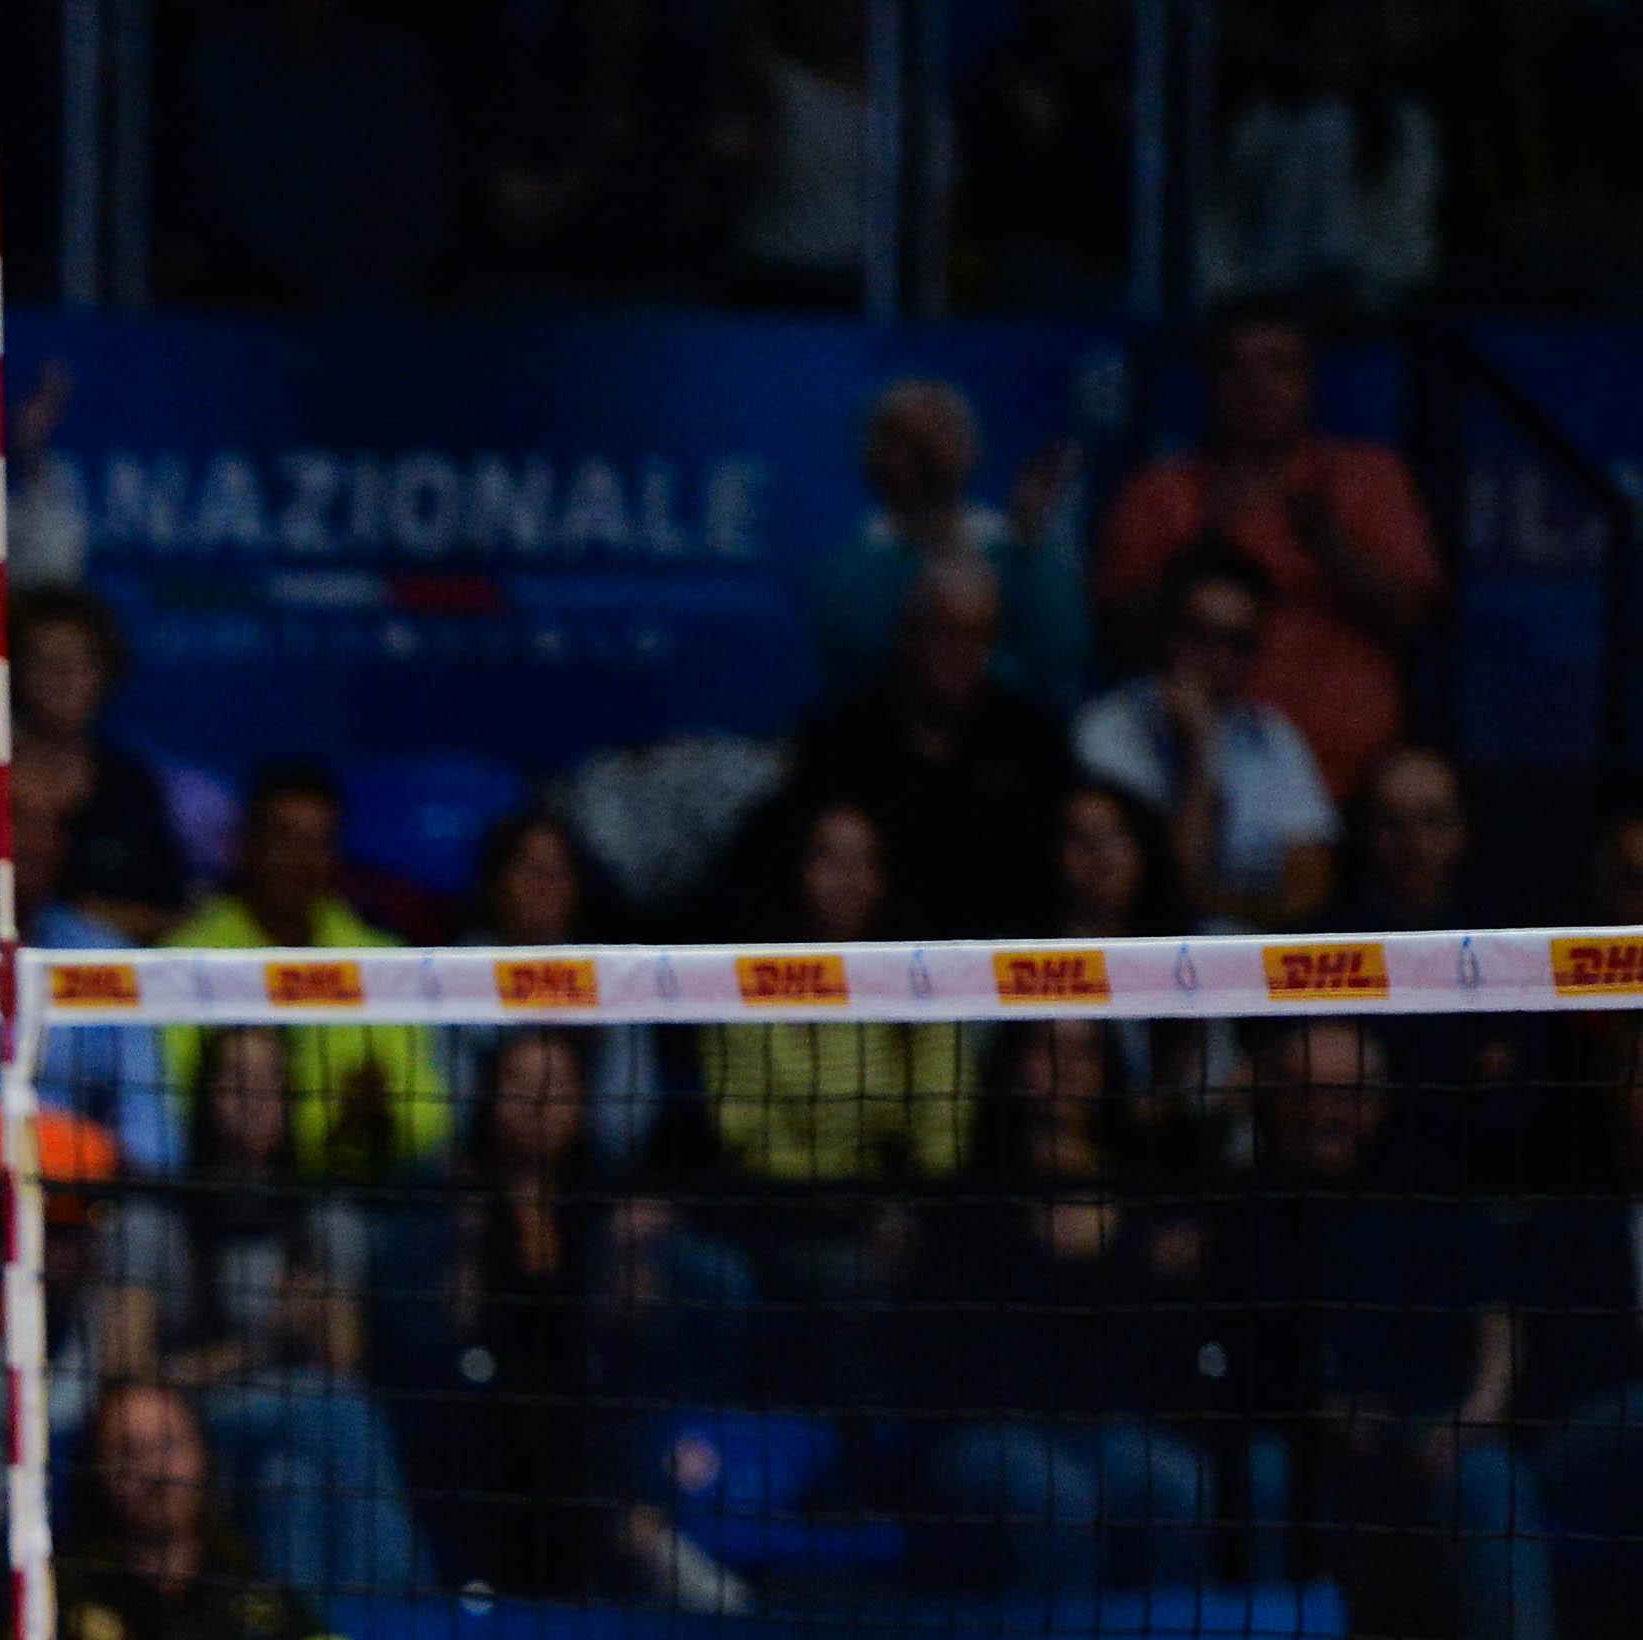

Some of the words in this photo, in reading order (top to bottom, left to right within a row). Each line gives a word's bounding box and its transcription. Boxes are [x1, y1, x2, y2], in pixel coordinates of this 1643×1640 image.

[752, 961, 835, 996] DHL
[1008, 956, 1096, 994] DHL
[1280, 949, 1373, 989] DHL
[1568, 944, 1643, 986] DH
